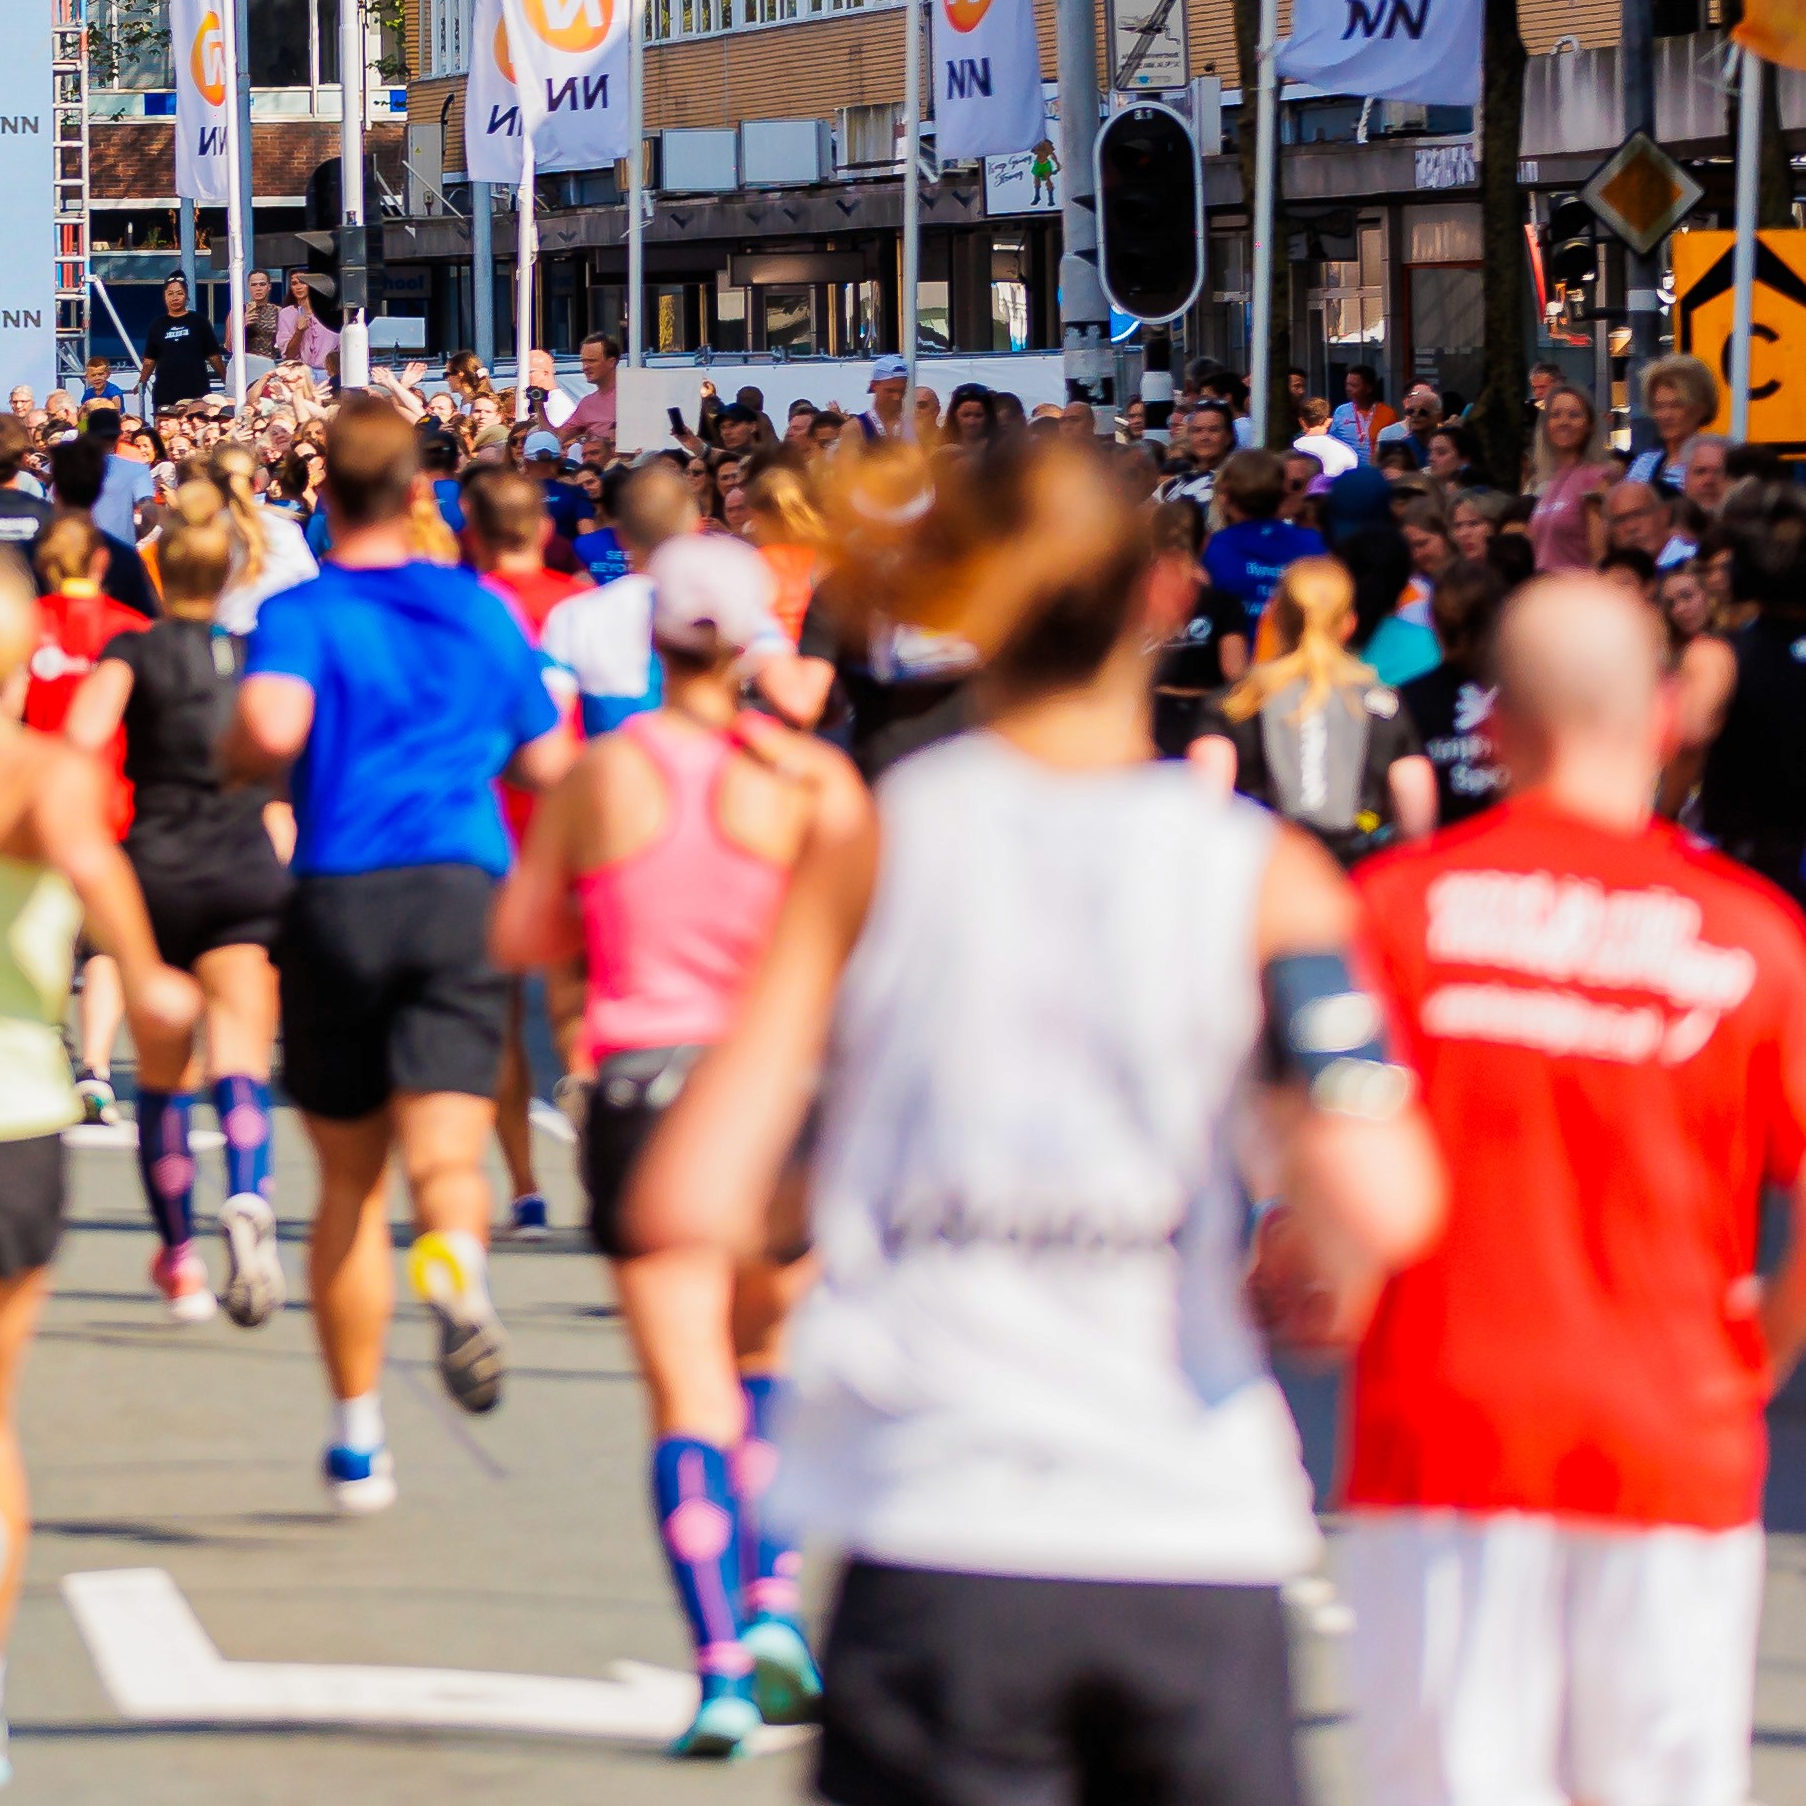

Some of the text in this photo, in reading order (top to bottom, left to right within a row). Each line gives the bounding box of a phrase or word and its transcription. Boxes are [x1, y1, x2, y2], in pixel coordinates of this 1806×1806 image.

[946, 57, 993, 101] NN
[0, 115, 40, 136] NN
[2, 309, 43, 329] NN
